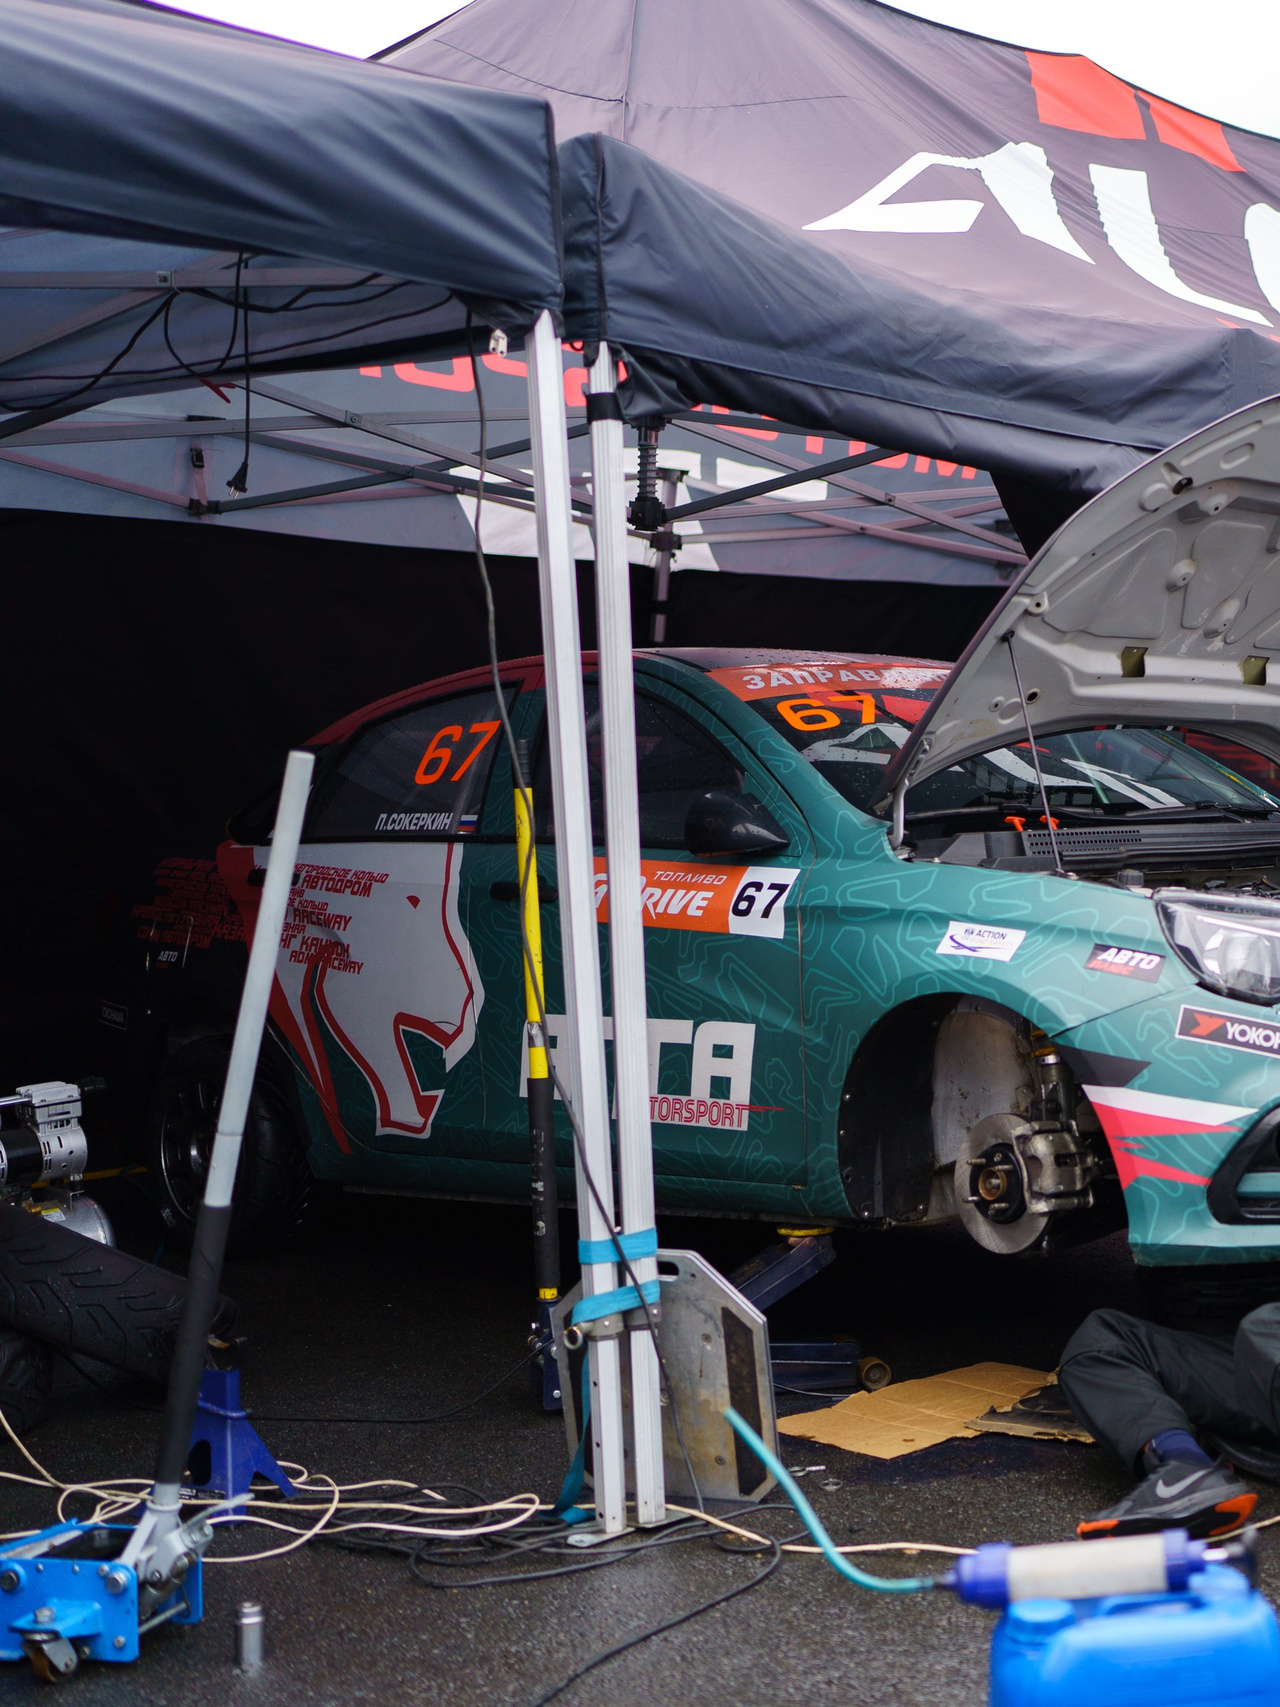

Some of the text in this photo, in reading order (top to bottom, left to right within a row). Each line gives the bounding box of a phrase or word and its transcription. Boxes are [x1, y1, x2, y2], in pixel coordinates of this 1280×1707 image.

[776, 695, 876, 732] 67
[414, 720, 502, 785] 67
[375, 812, 454, 831] П.СОКЕРКИН
[301, 874, 374, 898] АВТОДРОМ
[350, 869, 390, 884] КОЛЬЦО
[653, 870, 728, 886] ТОПЛИВО
[298, 899, 329, 912] КОЛЬЦО
[731, 881, 791, 919] 67
[293, 908, 353, 932] RACEWAY
[976, 929, 1008, 941] ACTION
[1097, 947, 1161, 970] АВТО
